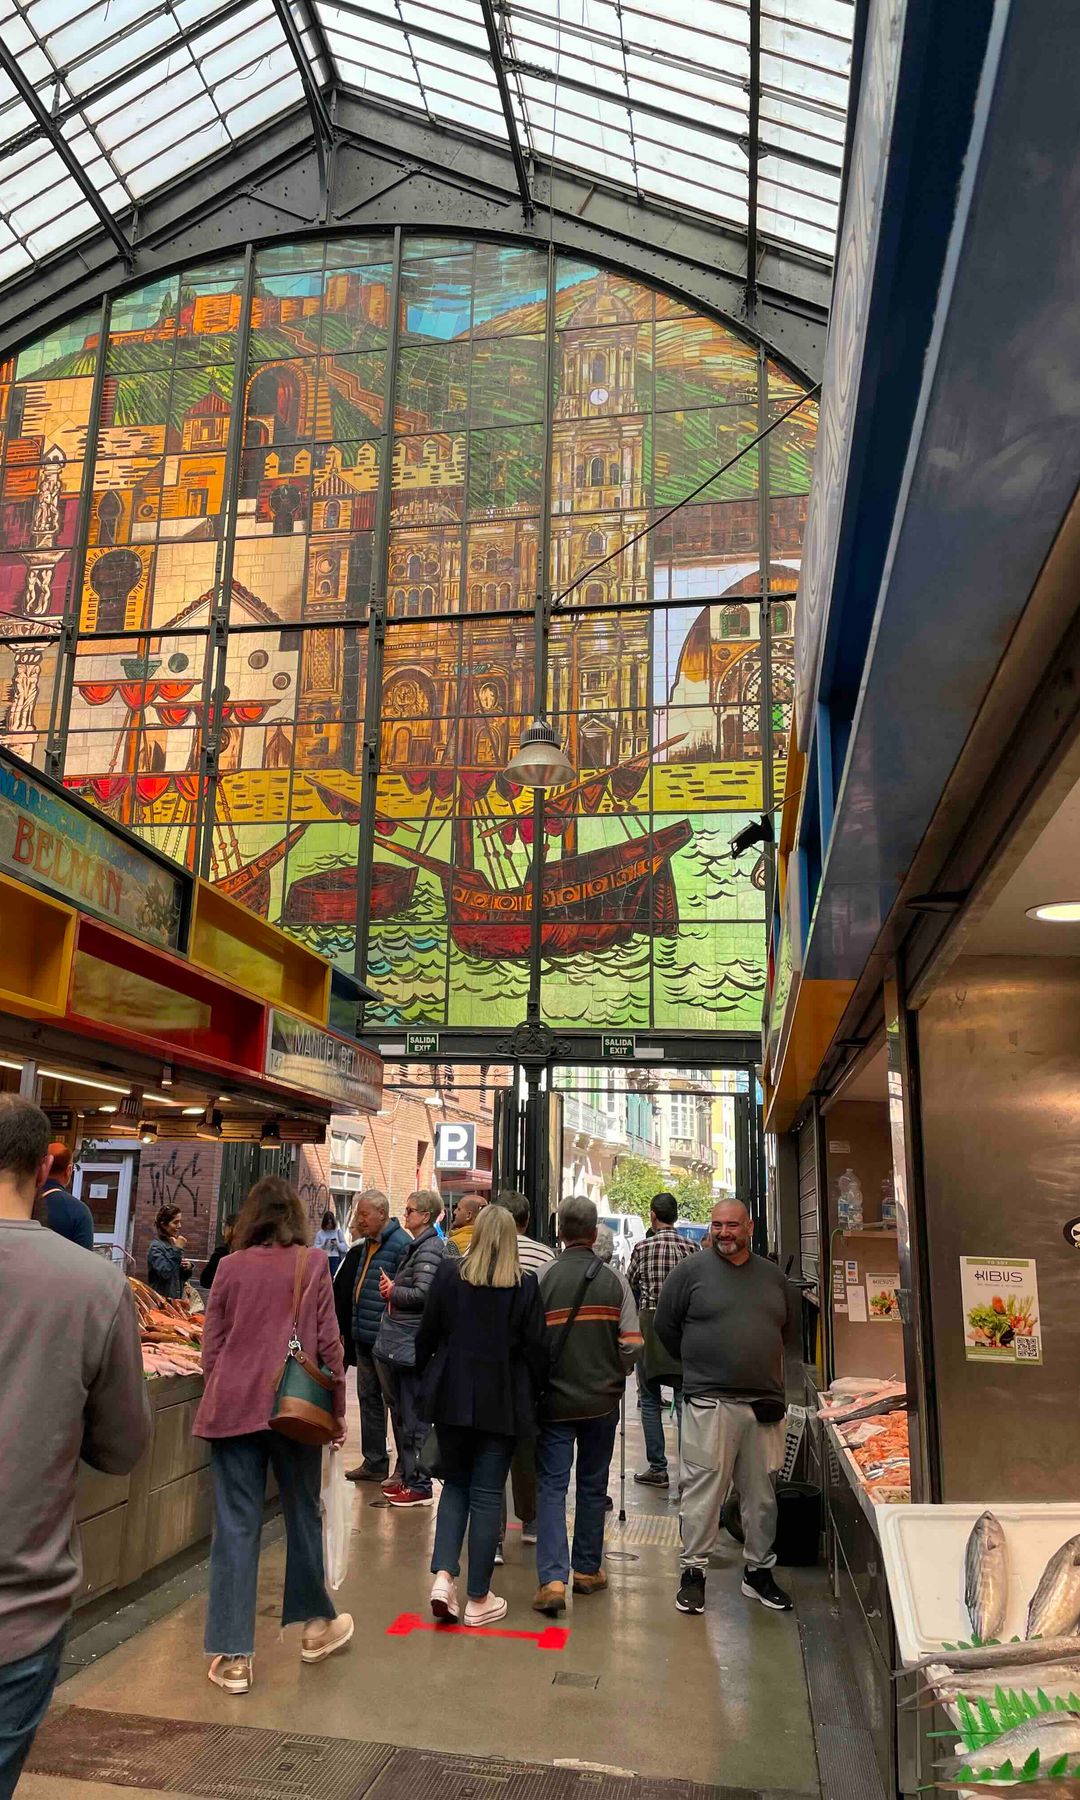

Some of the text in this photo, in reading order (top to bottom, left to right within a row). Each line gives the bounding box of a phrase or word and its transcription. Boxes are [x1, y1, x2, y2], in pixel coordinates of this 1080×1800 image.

[12, 815, 124, 915] BELMAN
[410, 1036, 436, 1044] SALIDA
[604, 1038, 633, 1047] SALIDA
[294, 1024, 337, 1070] MANUEL
[414, 1044, 431, 1052] EXIT
[609, 1047, 628, 1055] EXIT
[440, 1125, 468, 1161] P
[974, 1270, 1023, 1283] KIBUS
